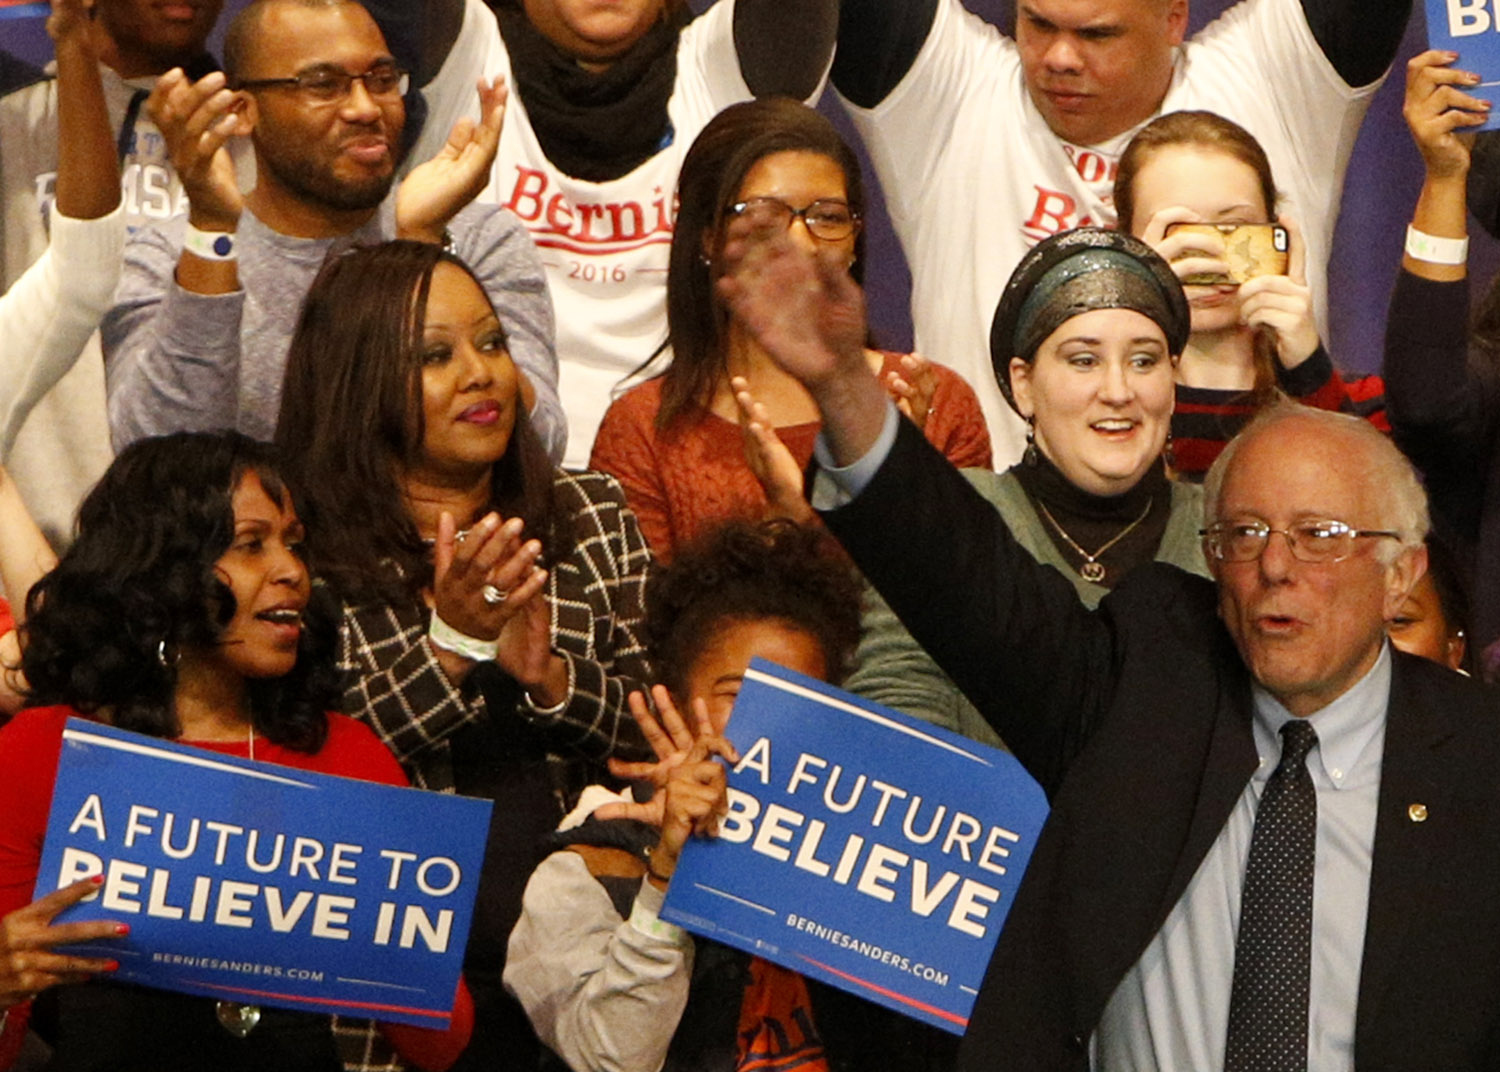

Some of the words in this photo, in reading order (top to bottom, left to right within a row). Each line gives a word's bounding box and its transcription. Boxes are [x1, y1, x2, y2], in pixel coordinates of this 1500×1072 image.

[502, 165, 681, 243] Berni
[568, 260, 627, 283] 2016
[68, 793, 107, 841] A
[123, 804, 364, 886] FUTURE
[379, 848, 463, 898] TO
[731, 736, 772, 786] A
[786, 751, 1021, 876] FUTURE
[56, 846, 357, 941] BELIEVE
[373, 902, 454, 954] IN
[717, 785, 1001, 941] BELIEVE
[152, 951, 325, 984] BERNIESANDERS.COM
[786, 913, 950, 989] BERNIESANDERS.COM
